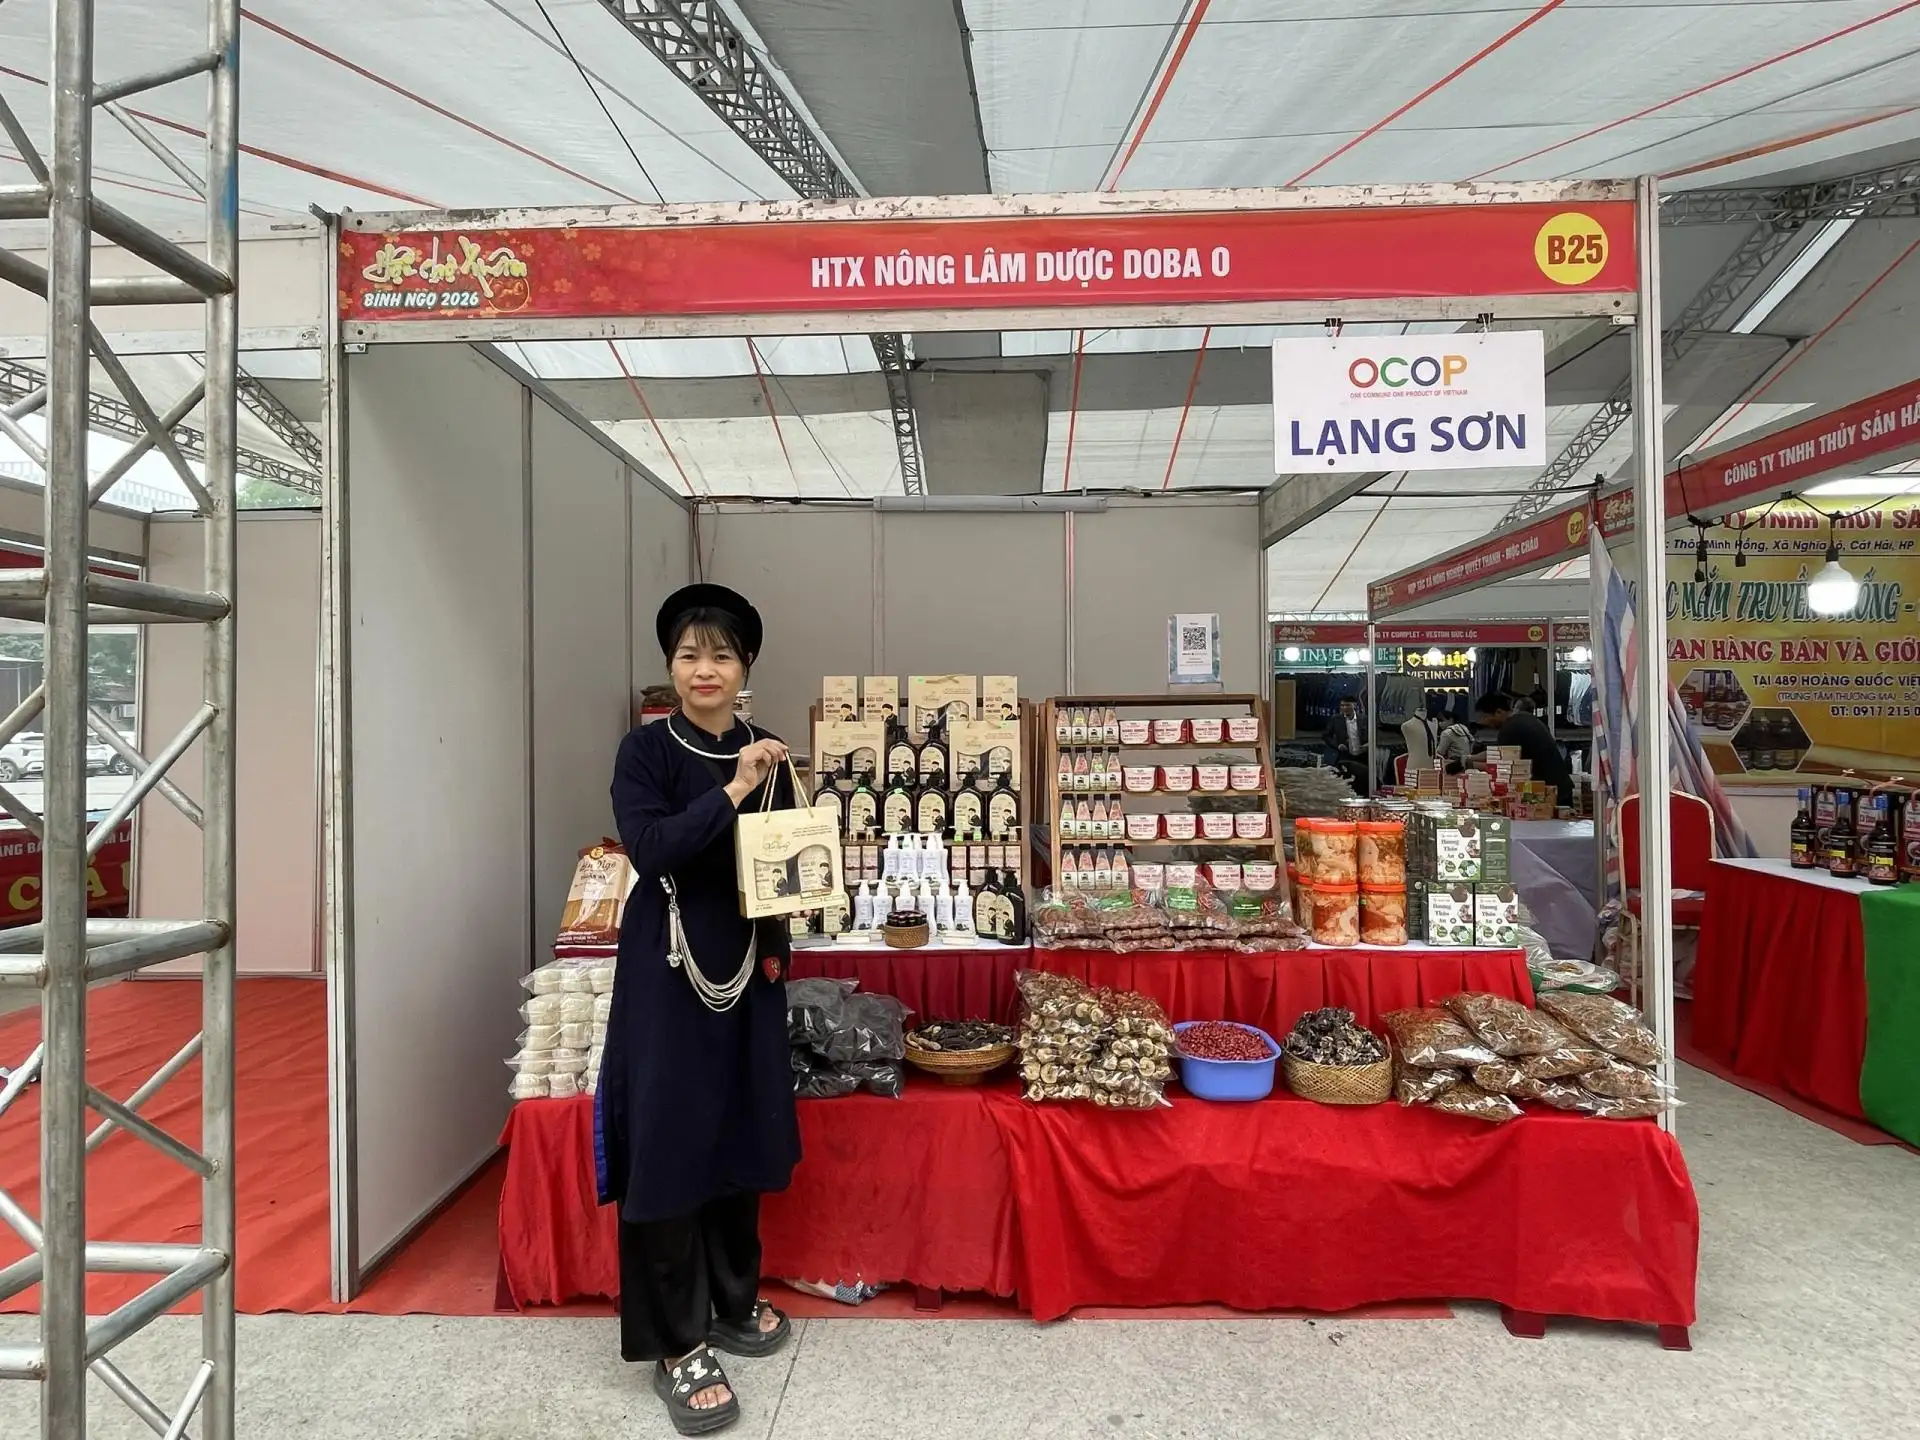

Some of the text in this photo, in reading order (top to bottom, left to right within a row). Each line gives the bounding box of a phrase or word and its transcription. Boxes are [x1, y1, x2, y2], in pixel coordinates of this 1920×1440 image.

[1547, 234, 1603, 265] B25
[811, 256, 866, 288] HTX
[874, 248, 956, 287] NÔNG
[964, 247, 1026, 285] LÂM
[1036, 247, 1114, 288] DƯỢC
[1123, 248, 1203, 280] DOBA
[363, 290, 480, 310] BÍNH NGỌ 2026
[1348, 354, 1468, 389] OCOP
[1291, 410, 1526, 466] LẠNG SƠN
[1724, 459, 1758, 487] CÔNG
[1760, 453, 1776, 475] TY
[1778, 439, 1815, 468] TNHH
[1818, 422, 1857, 456] THỦY
[1861, 409, 1896, 442] SẢN
[1756, 510, 1819, 529] TNHH
[1898, 540, 1914, 550] HP
[1737, 563, 1820, 622] TRUYỀ
[1711, 636, 1774, 661] HÀNG
[1780, 636, 1831, 662] BÁN
[1835, 636, 1869, 662] VÀ
[1752, 675, 1771, 689] TẠI
[1775, 675, 1798, 686] 489
[1801, 672, 1851, 686] HOÀNG
[1855, 671, 1894, 686] QUỐC
[1831, 705, 1849, 716] ĐT:
[1853, 705, 1882, 716] 0917
[1887, 705, 1910, 716] 215
